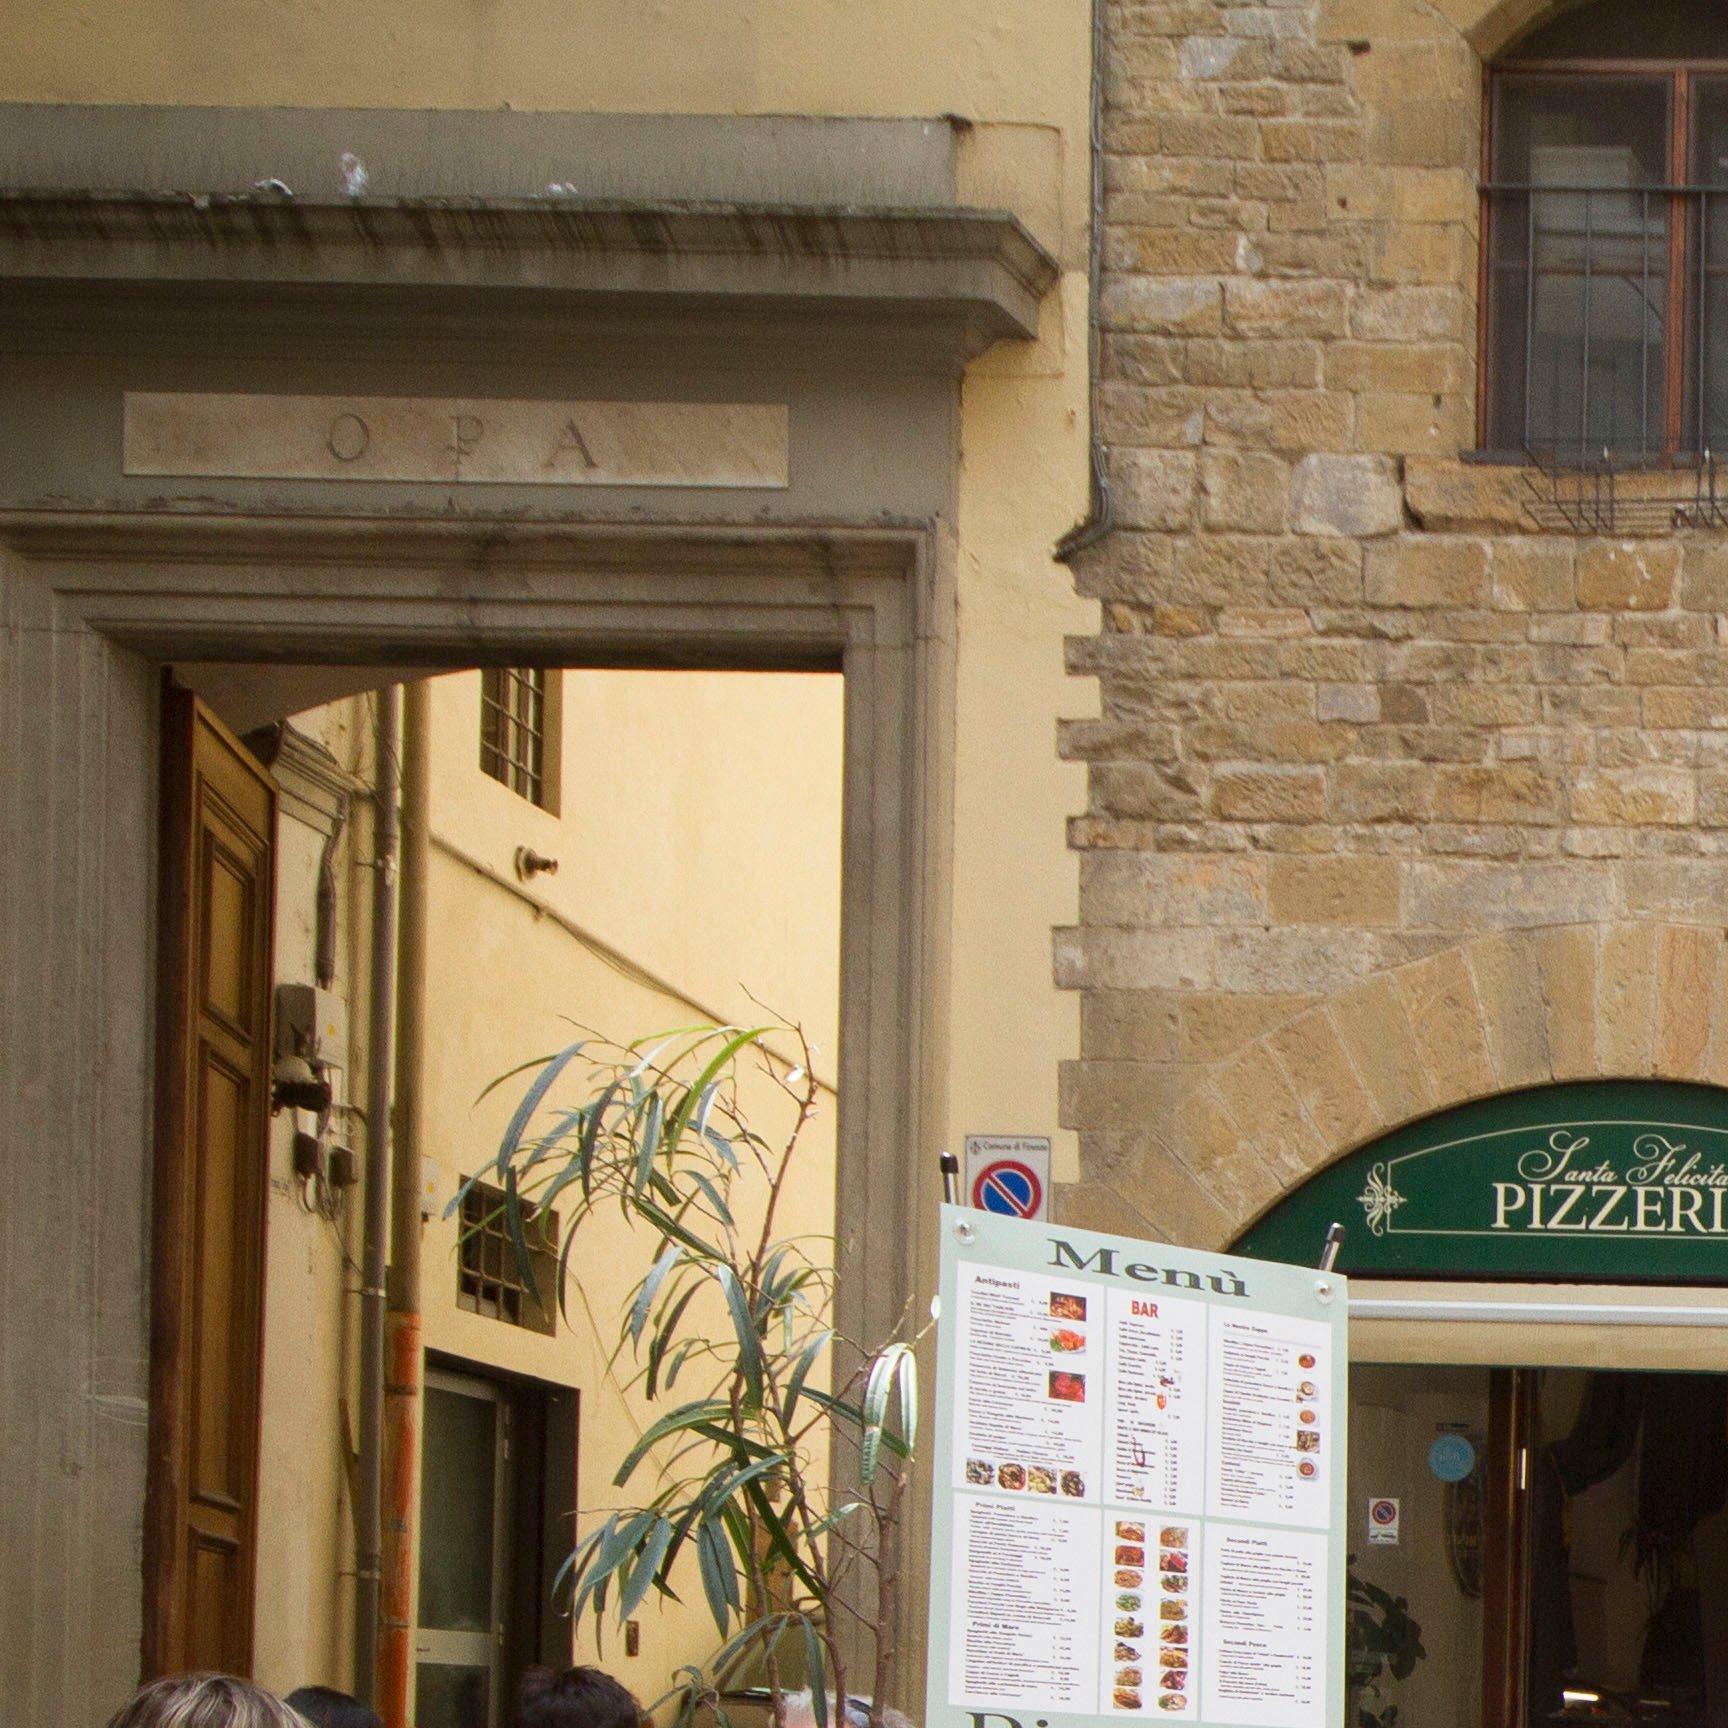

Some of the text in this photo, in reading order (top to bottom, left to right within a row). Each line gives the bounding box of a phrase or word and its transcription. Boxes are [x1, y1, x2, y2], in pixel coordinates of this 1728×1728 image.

[1517, 1130, 1618, 1182] Santa
[975, 1275, 1020, 1290] Antipasti
[1046, 1238, 1250, 1298] Menù
[1131, 1300, 1159, 1318] BAR
